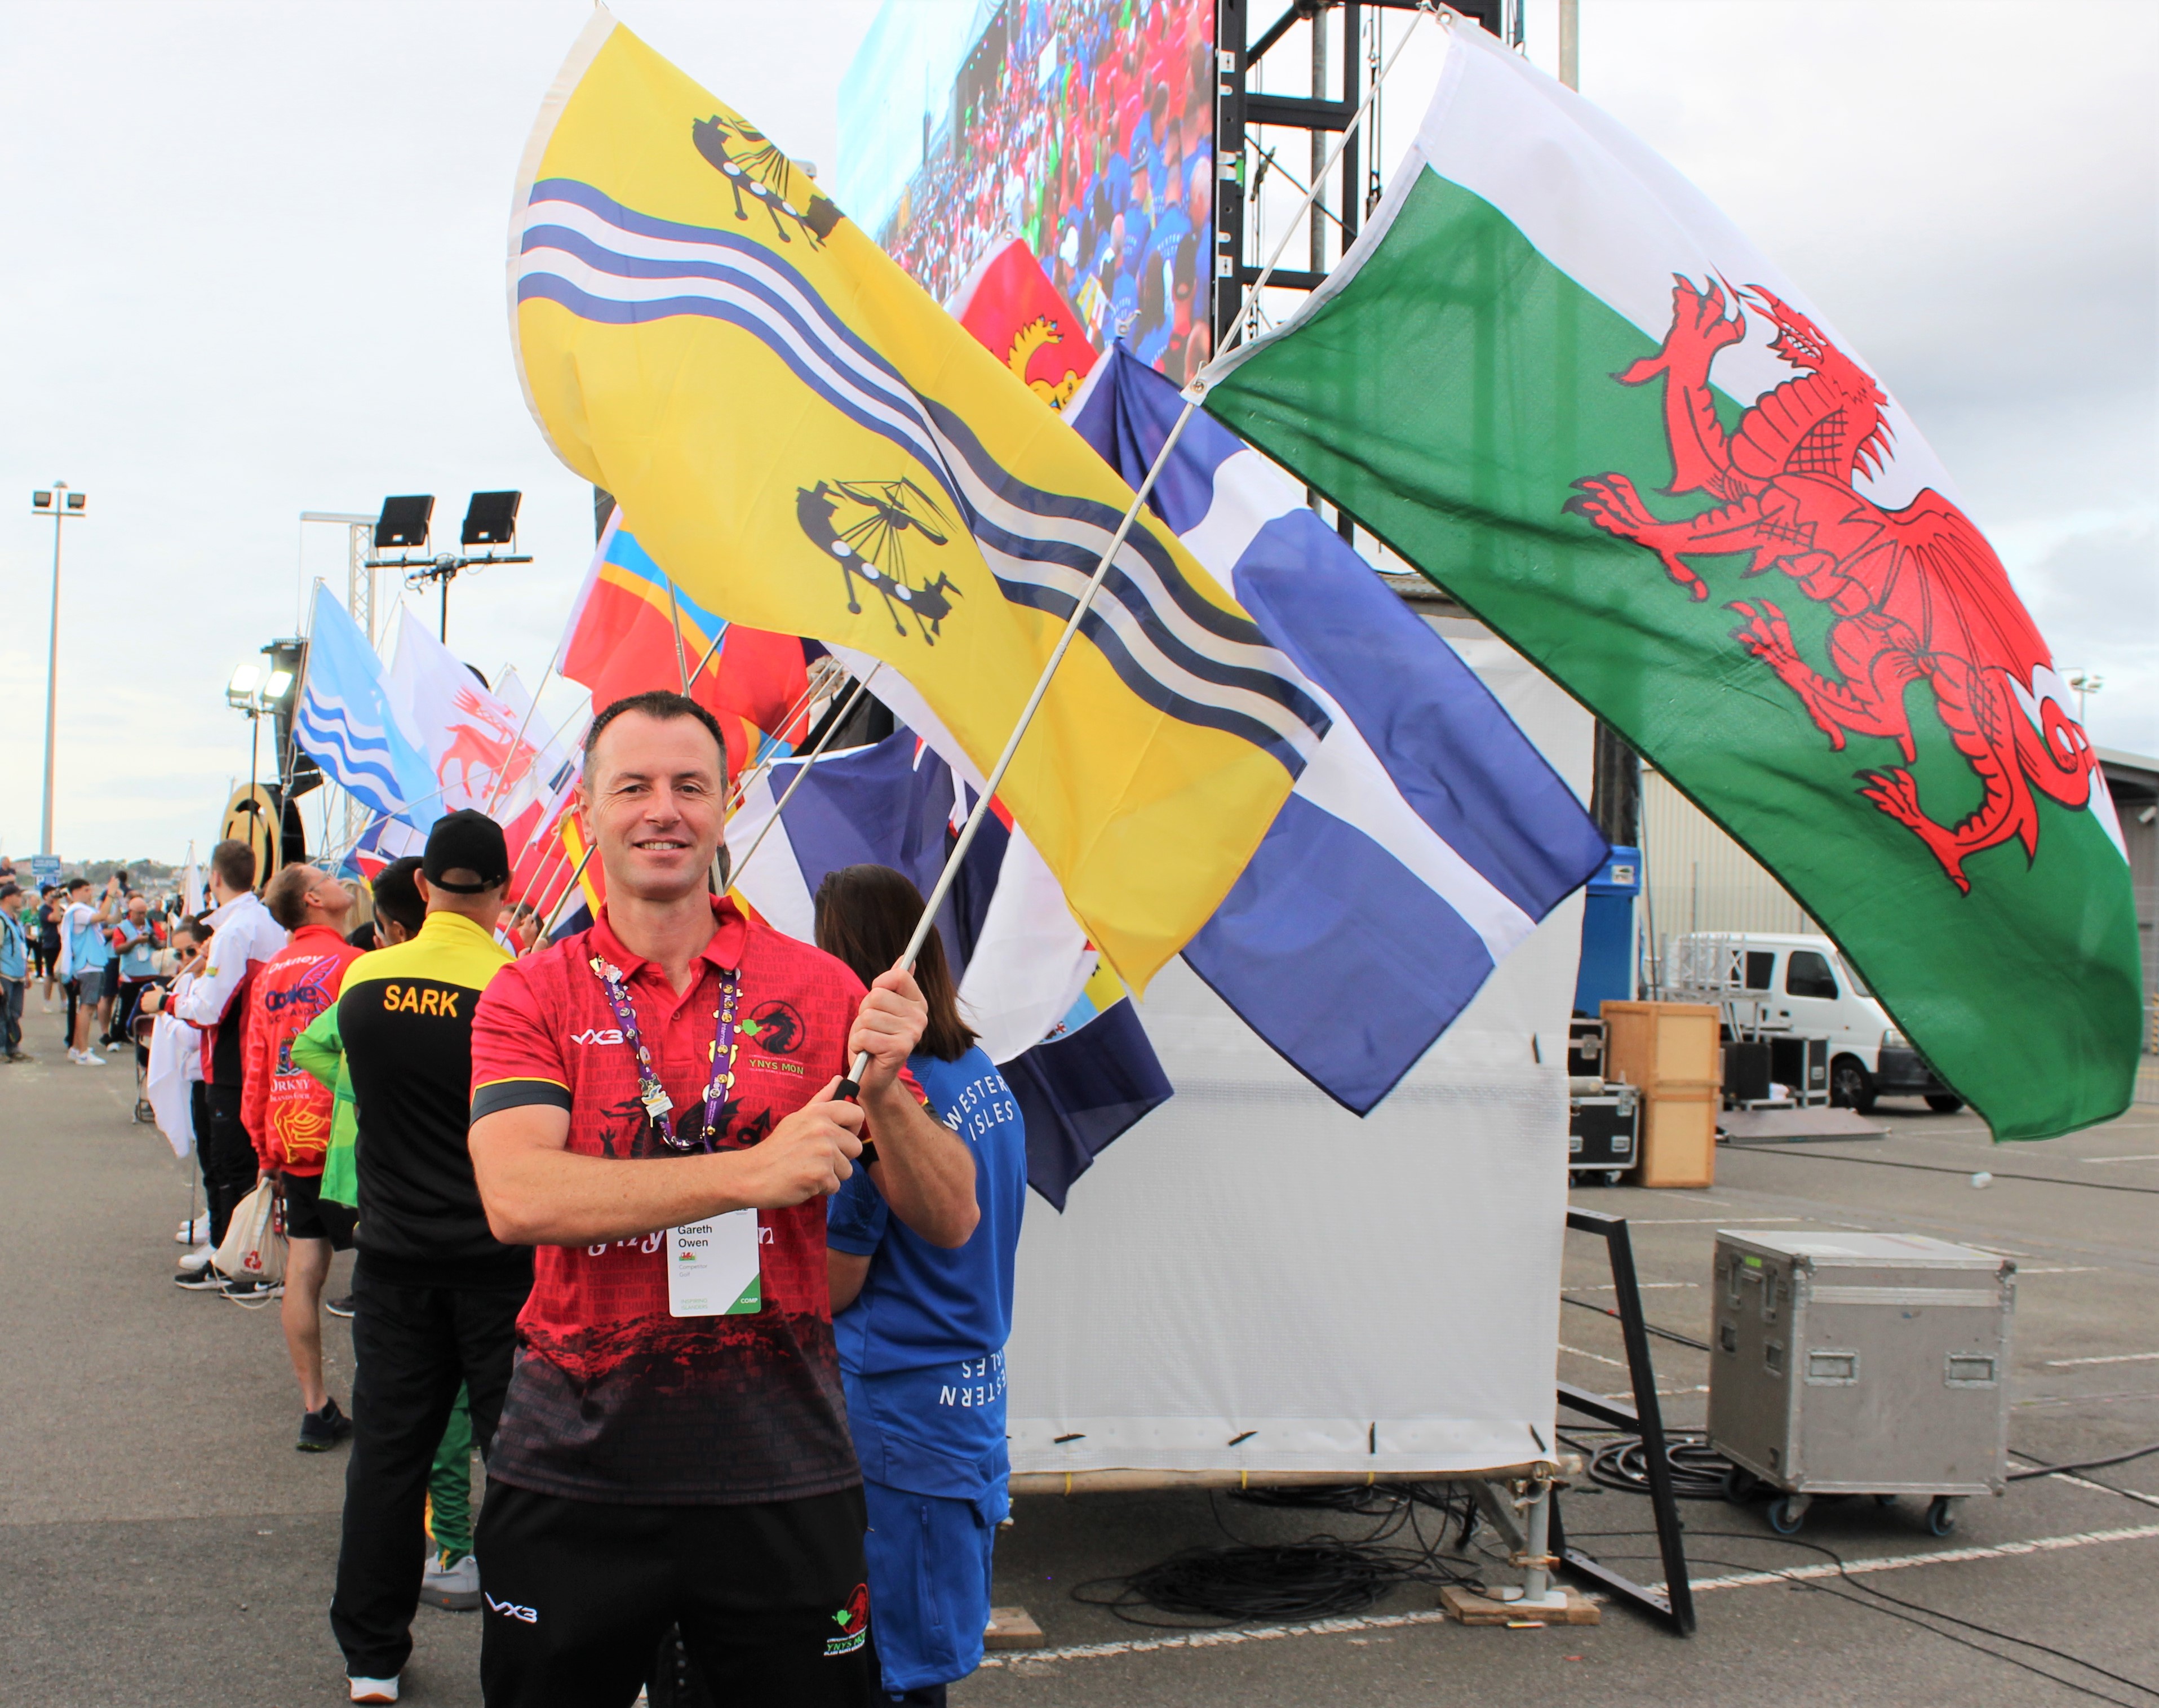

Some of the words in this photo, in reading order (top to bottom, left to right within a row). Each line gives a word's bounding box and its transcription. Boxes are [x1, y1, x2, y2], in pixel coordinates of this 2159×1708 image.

[268, 955, 325, 975] Orkney
[383, 984, 459, 1018] SARK
[569, 1028, 624, 1046] VX3
[749, 1059, 778, 1070] YNYS
[942, 1075, 1009, 1132] WESTER
[968, 1100, 1014, 1142] ISLES
[677, 1225, 712, 1235] Gareth
[679, 1238, 708, 1248] Owen
[939, 1368, 1007, 1408] ESTERN
[485, 1591, 538, 1623] VX3
